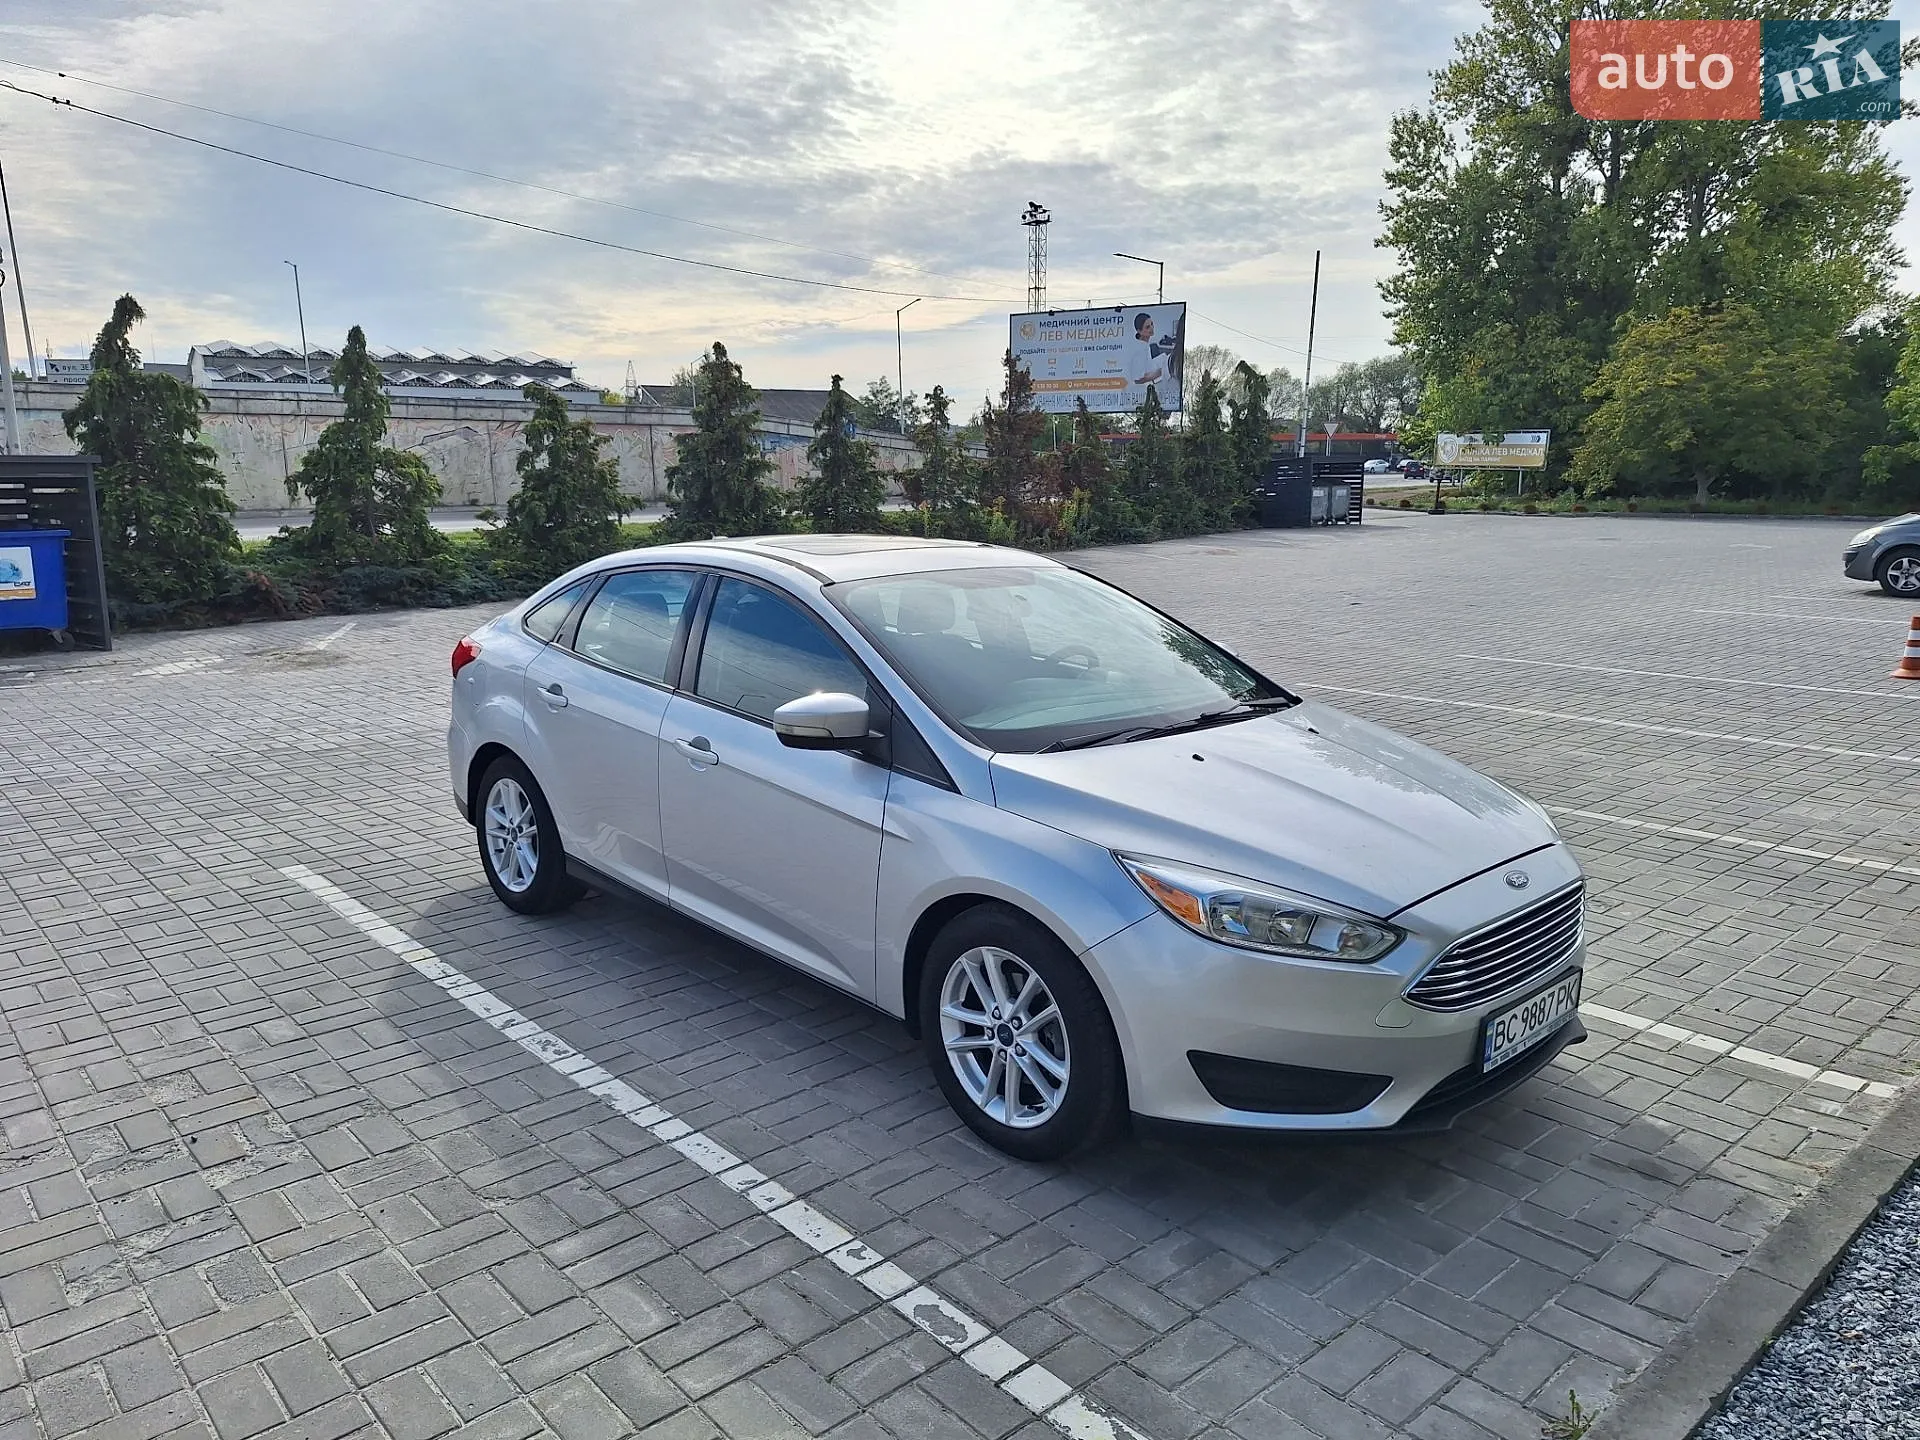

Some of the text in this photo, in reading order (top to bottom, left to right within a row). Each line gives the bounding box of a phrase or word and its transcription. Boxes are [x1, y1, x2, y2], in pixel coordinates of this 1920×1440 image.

[1039, 315, 1124, 329] медичний центр
[1039, 326, 1124, 341] ЛЕВ МЕДІКАЛ
[1491, 447, 1508, 456] ЛЕВ
[1509, 447, 1545, 457] МЕДІКАЛ
[1493, 1013, 1518, 1053] BC
[1520, 990, 1556, 1038] 9887
[1555, 978, 1578, 1016] PK
